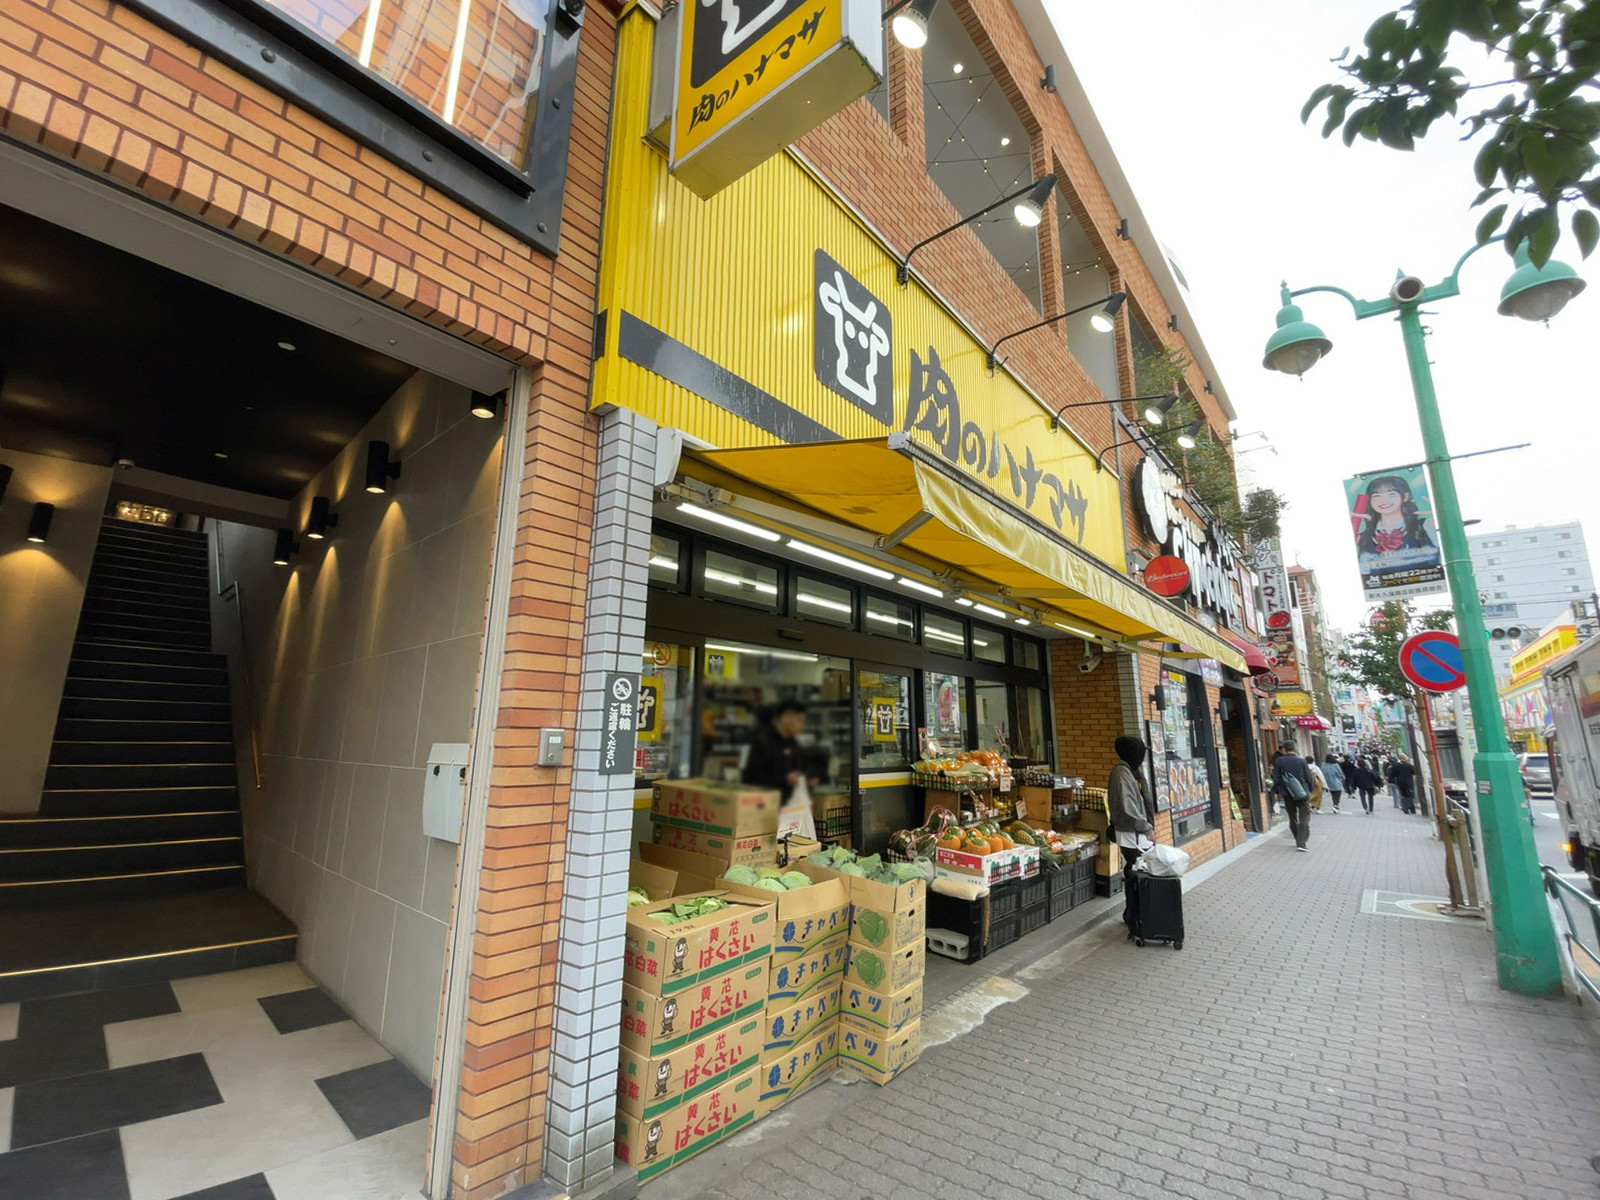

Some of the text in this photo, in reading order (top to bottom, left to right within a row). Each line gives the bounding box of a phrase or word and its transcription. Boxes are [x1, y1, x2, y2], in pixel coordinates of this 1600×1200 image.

[687, 4, 827, 134] 肉のハナマサ
[903, 345, 1088, 545] 肉のハナマサ
[1263, 572, 1278, 612] トマト
[619, 702, 633, 731] 駐輪
[605, 702, 620, 769] ご遠慮ください
[668, 802, 715, 823] はくさい
[709, 920, 739, 944] 黄芯
[804, 906, 849, 935] キャベツ
[699, 933, 754, 969] はくさい
[797, 947, 843, 978] キャベツ
[701, 977, 732, 1003] 黄芯
[690, 990, 747, 1030] はくさい
[793, 989, 838, 1027] キャベツ
[694, 1033, 727, 1061] 黄芯
[789, 1032, 836, 1065] キャベツ
[683, 1045, 742, 1089] はくさい
[686, 1092, 721, 1122] 黄芯
[674, 1103, 737, 1151] はくさい
